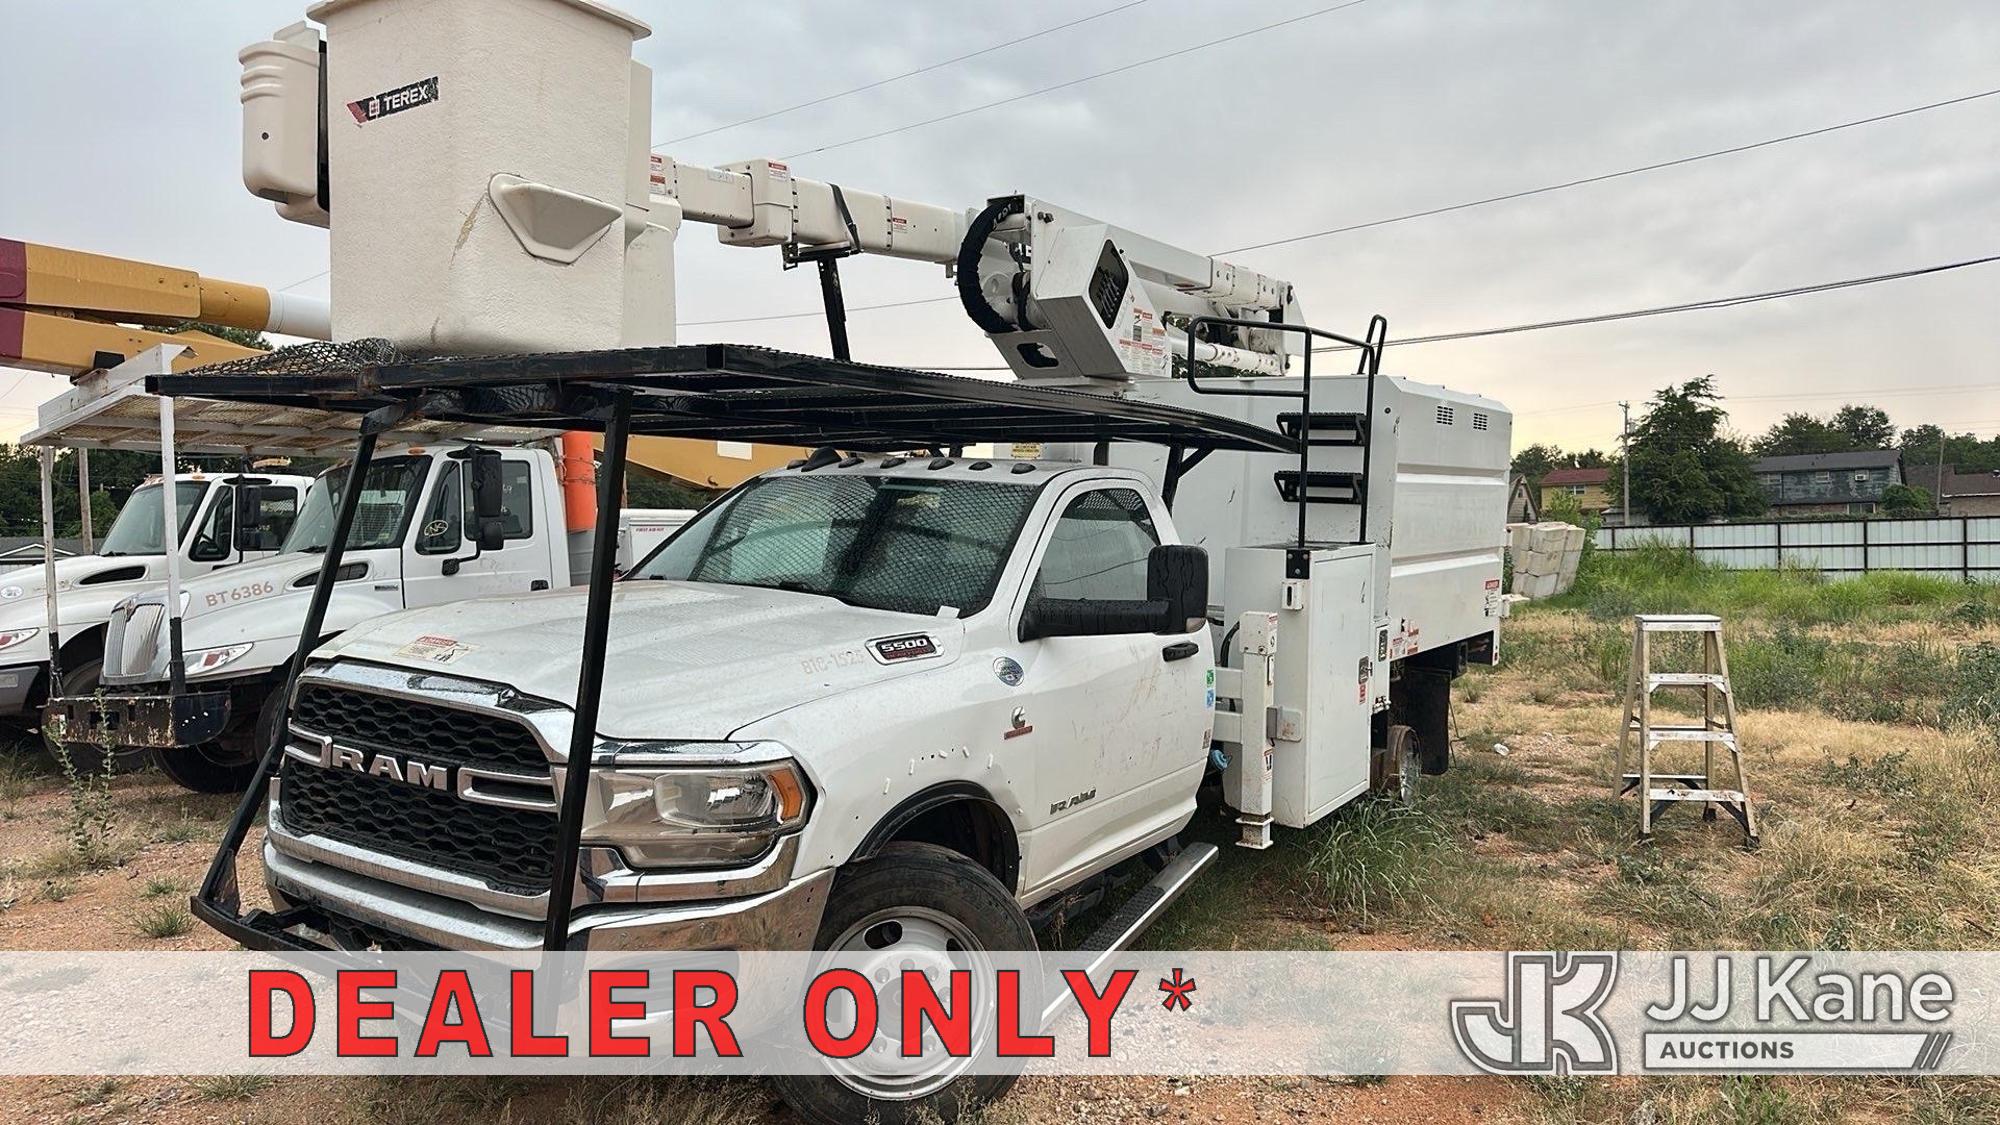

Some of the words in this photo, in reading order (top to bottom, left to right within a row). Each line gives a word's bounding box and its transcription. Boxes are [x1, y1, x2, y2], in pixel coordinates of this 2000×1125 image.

[384, 85, 428, 111] TEREX
[205, 590, 228, 607] BT
[231, 581, 273, 601] 6386
[881, 638, 928, 652] 5500
[332, 744, 448, 791] RAM
[1050, 788, 1096, 815] RAM
